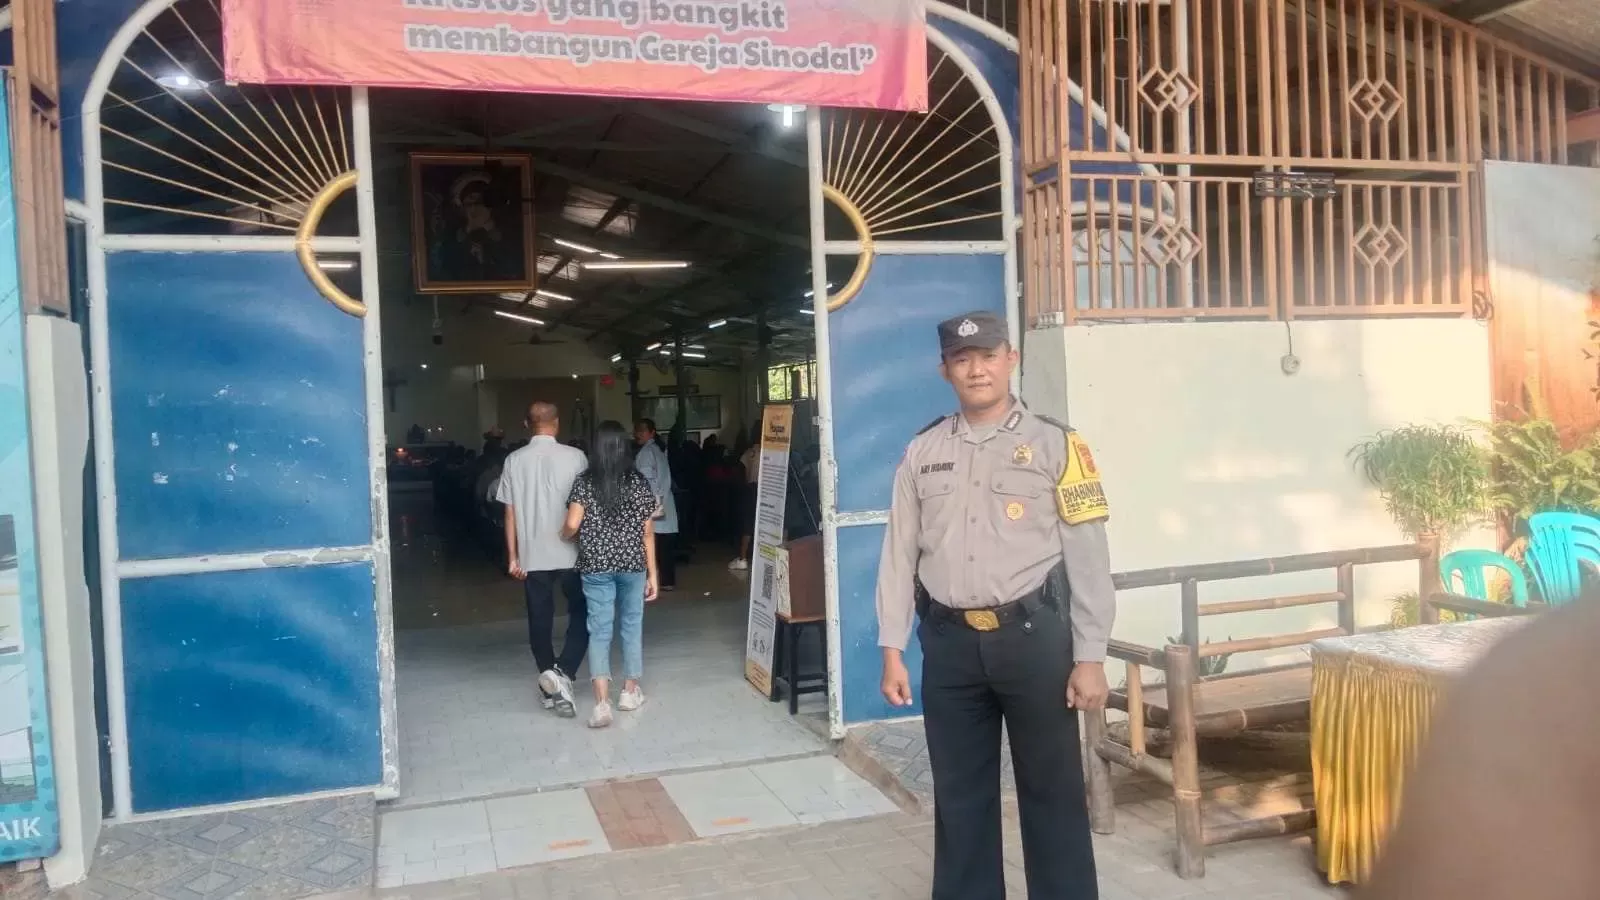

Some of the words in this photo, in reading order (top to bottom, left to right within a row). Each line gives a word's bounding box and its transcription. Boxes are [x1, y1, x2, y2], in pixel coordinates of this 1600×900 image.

[545, 0, 638, 25] yang
[650, 0, 785, 31] bangkit
[408, 27, 632, 63] membangun
[640, 36, 738, 69] Gereja
